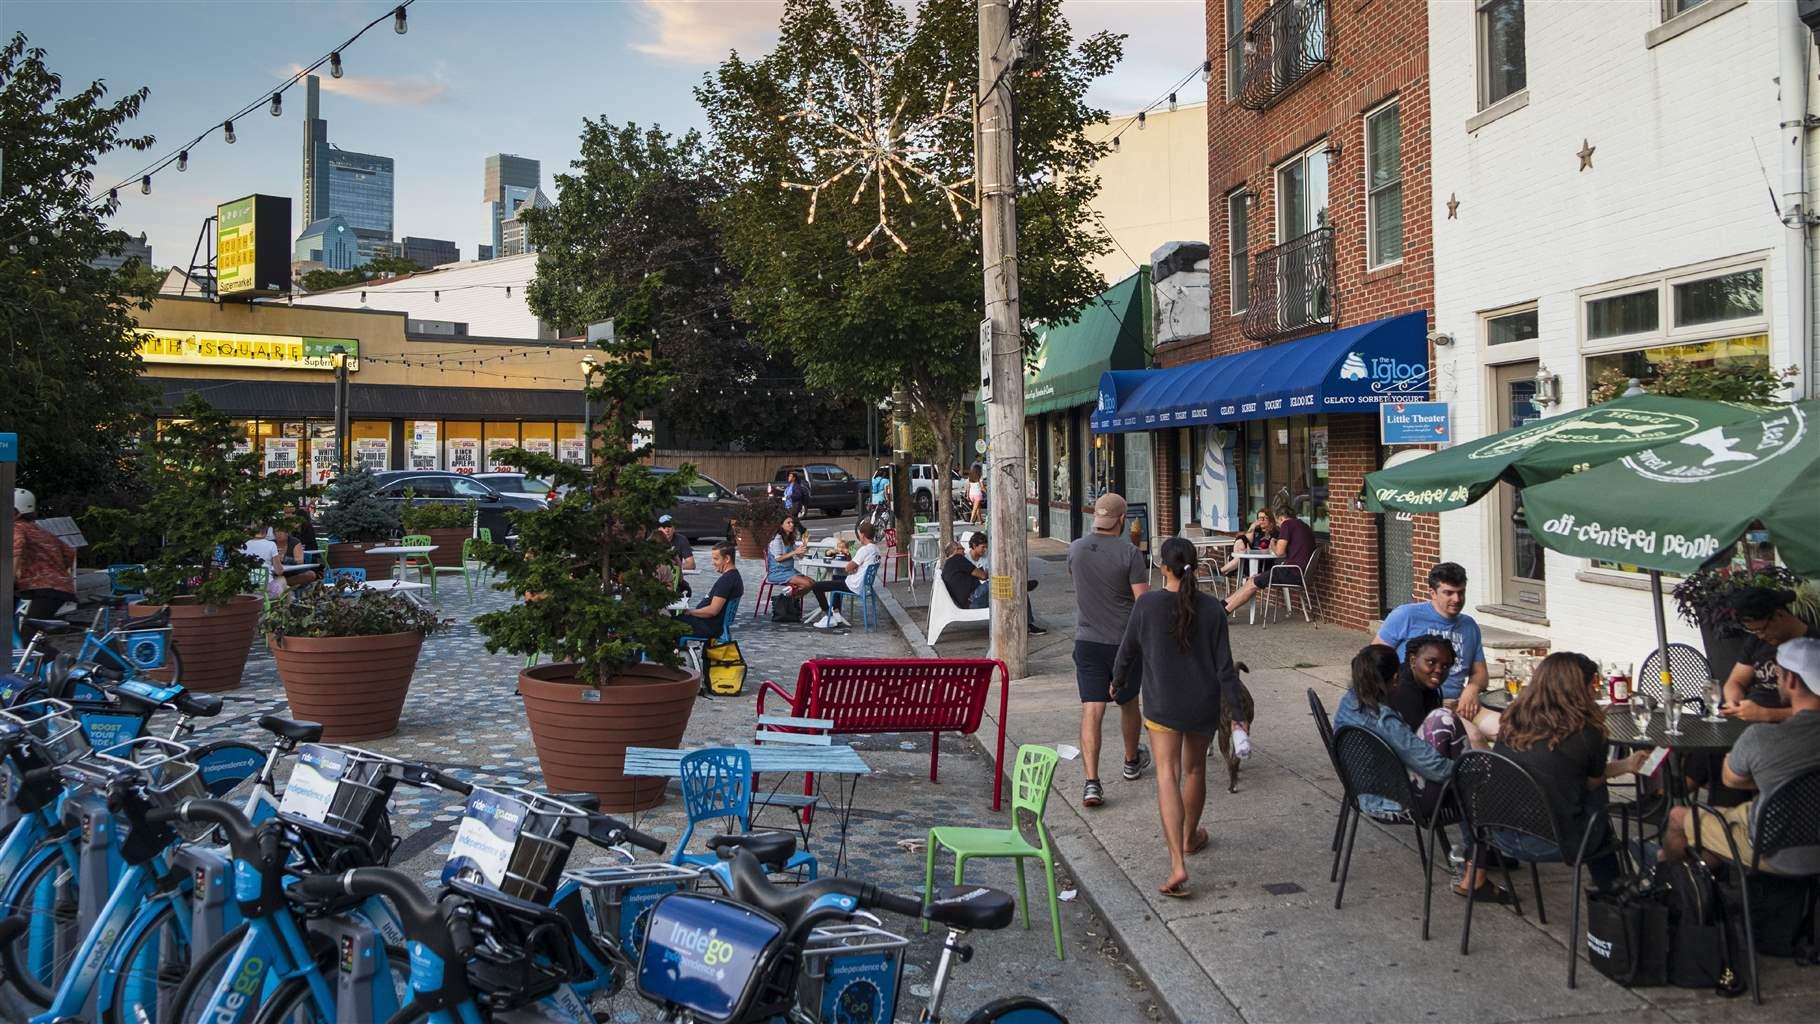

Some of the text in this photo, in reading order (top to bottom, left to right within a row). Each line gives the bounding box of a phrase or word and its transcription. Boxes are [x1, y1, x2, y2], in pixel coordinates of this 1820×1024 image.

[220, 249, 255, 269] SQUARE
[220, 277, 252, 291] Supermarket
[205, 342, 298, 359] SQUARE
[1371, 358, 1425, 383] Igloo
[1324, 396, 1355, 404] GELATO
[1391, 395, 1424, 403] YOGURT
[1220, 407, 1235, 416] GELATO
[1241, 403, 1256, 413] SORBET
[1265, 400, 1282, 410] YOGURT
[1387, 414, 1446, 423] Little Theater
[1606, 411, 1671, 424] Head
[1616, 431, 1667, 440] Ales
[1543, 513, 1719, 559] off-centered people
[91, 723, 122, 731] BOOST
[90, 731, 115, 739] YOUR
[204, 760, 248, 773] Independence
[669, 921, 734, 965] Indego
[833, 963, 880, 975] Independence
